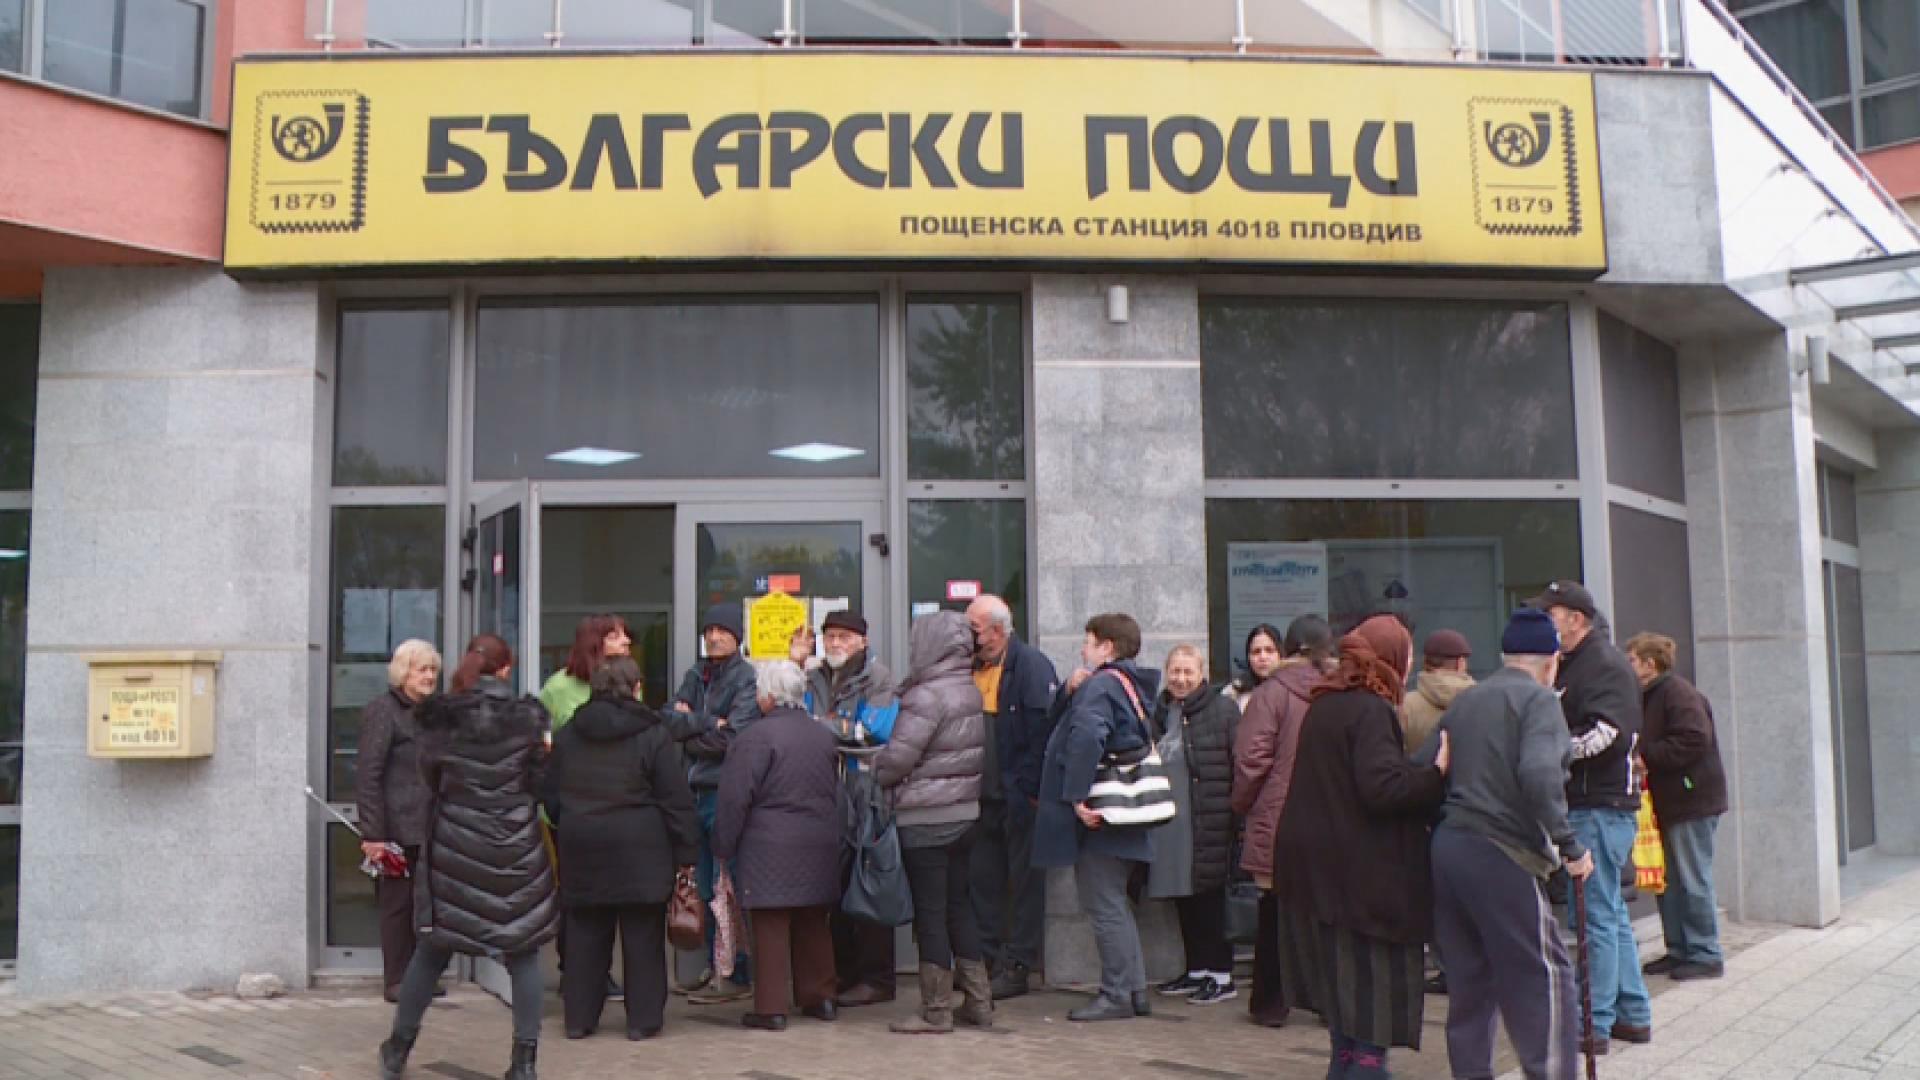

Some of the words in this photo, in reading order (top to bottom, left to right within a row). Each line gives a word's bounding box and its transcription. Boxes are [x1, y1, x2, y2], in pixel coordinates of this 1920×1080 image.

[423, 111, 1025, 199] БЪЛГАРСКИ
[1084, 115, 1418, 209] ПОЩИ
[270, 192, 339, 211] 1879
[1490, 196, 1555, 214] 1879
[900, 215, 1064, 239] ПОЩЕНСКА
[1073, 217, 1208, 241] СТАНЦИЯ
[1216, 219, 1281, 239] 4018
[1290, 220, 1423, 245] ПЛОВДИВ
